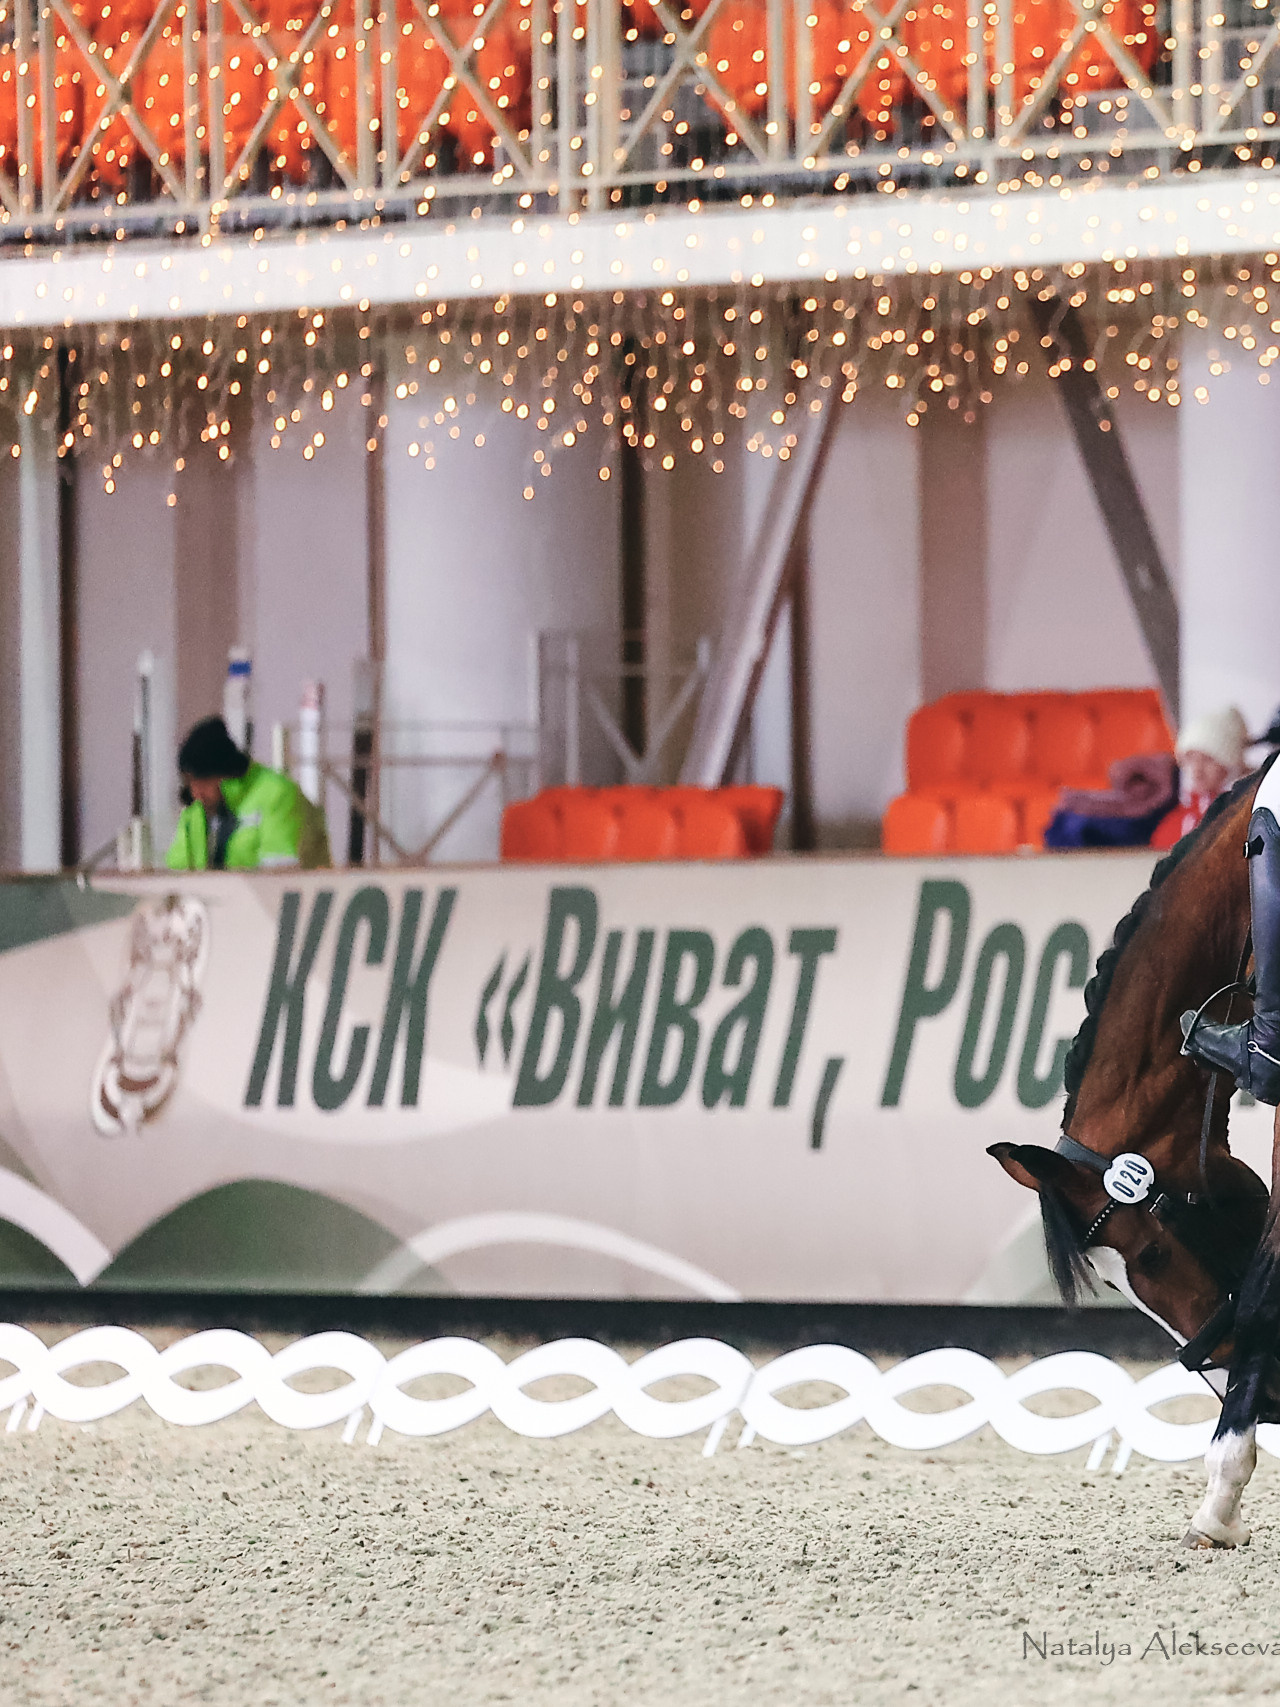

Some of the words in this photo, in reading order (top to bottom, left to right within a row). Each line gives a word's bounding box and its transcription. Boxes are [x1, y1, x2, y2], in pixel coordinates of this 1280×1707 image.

[244, 887, 456, 1109] КСК
[474, 885, 844, 1149] «Виват,
[1112, 1160, 1148, 1198] 020
